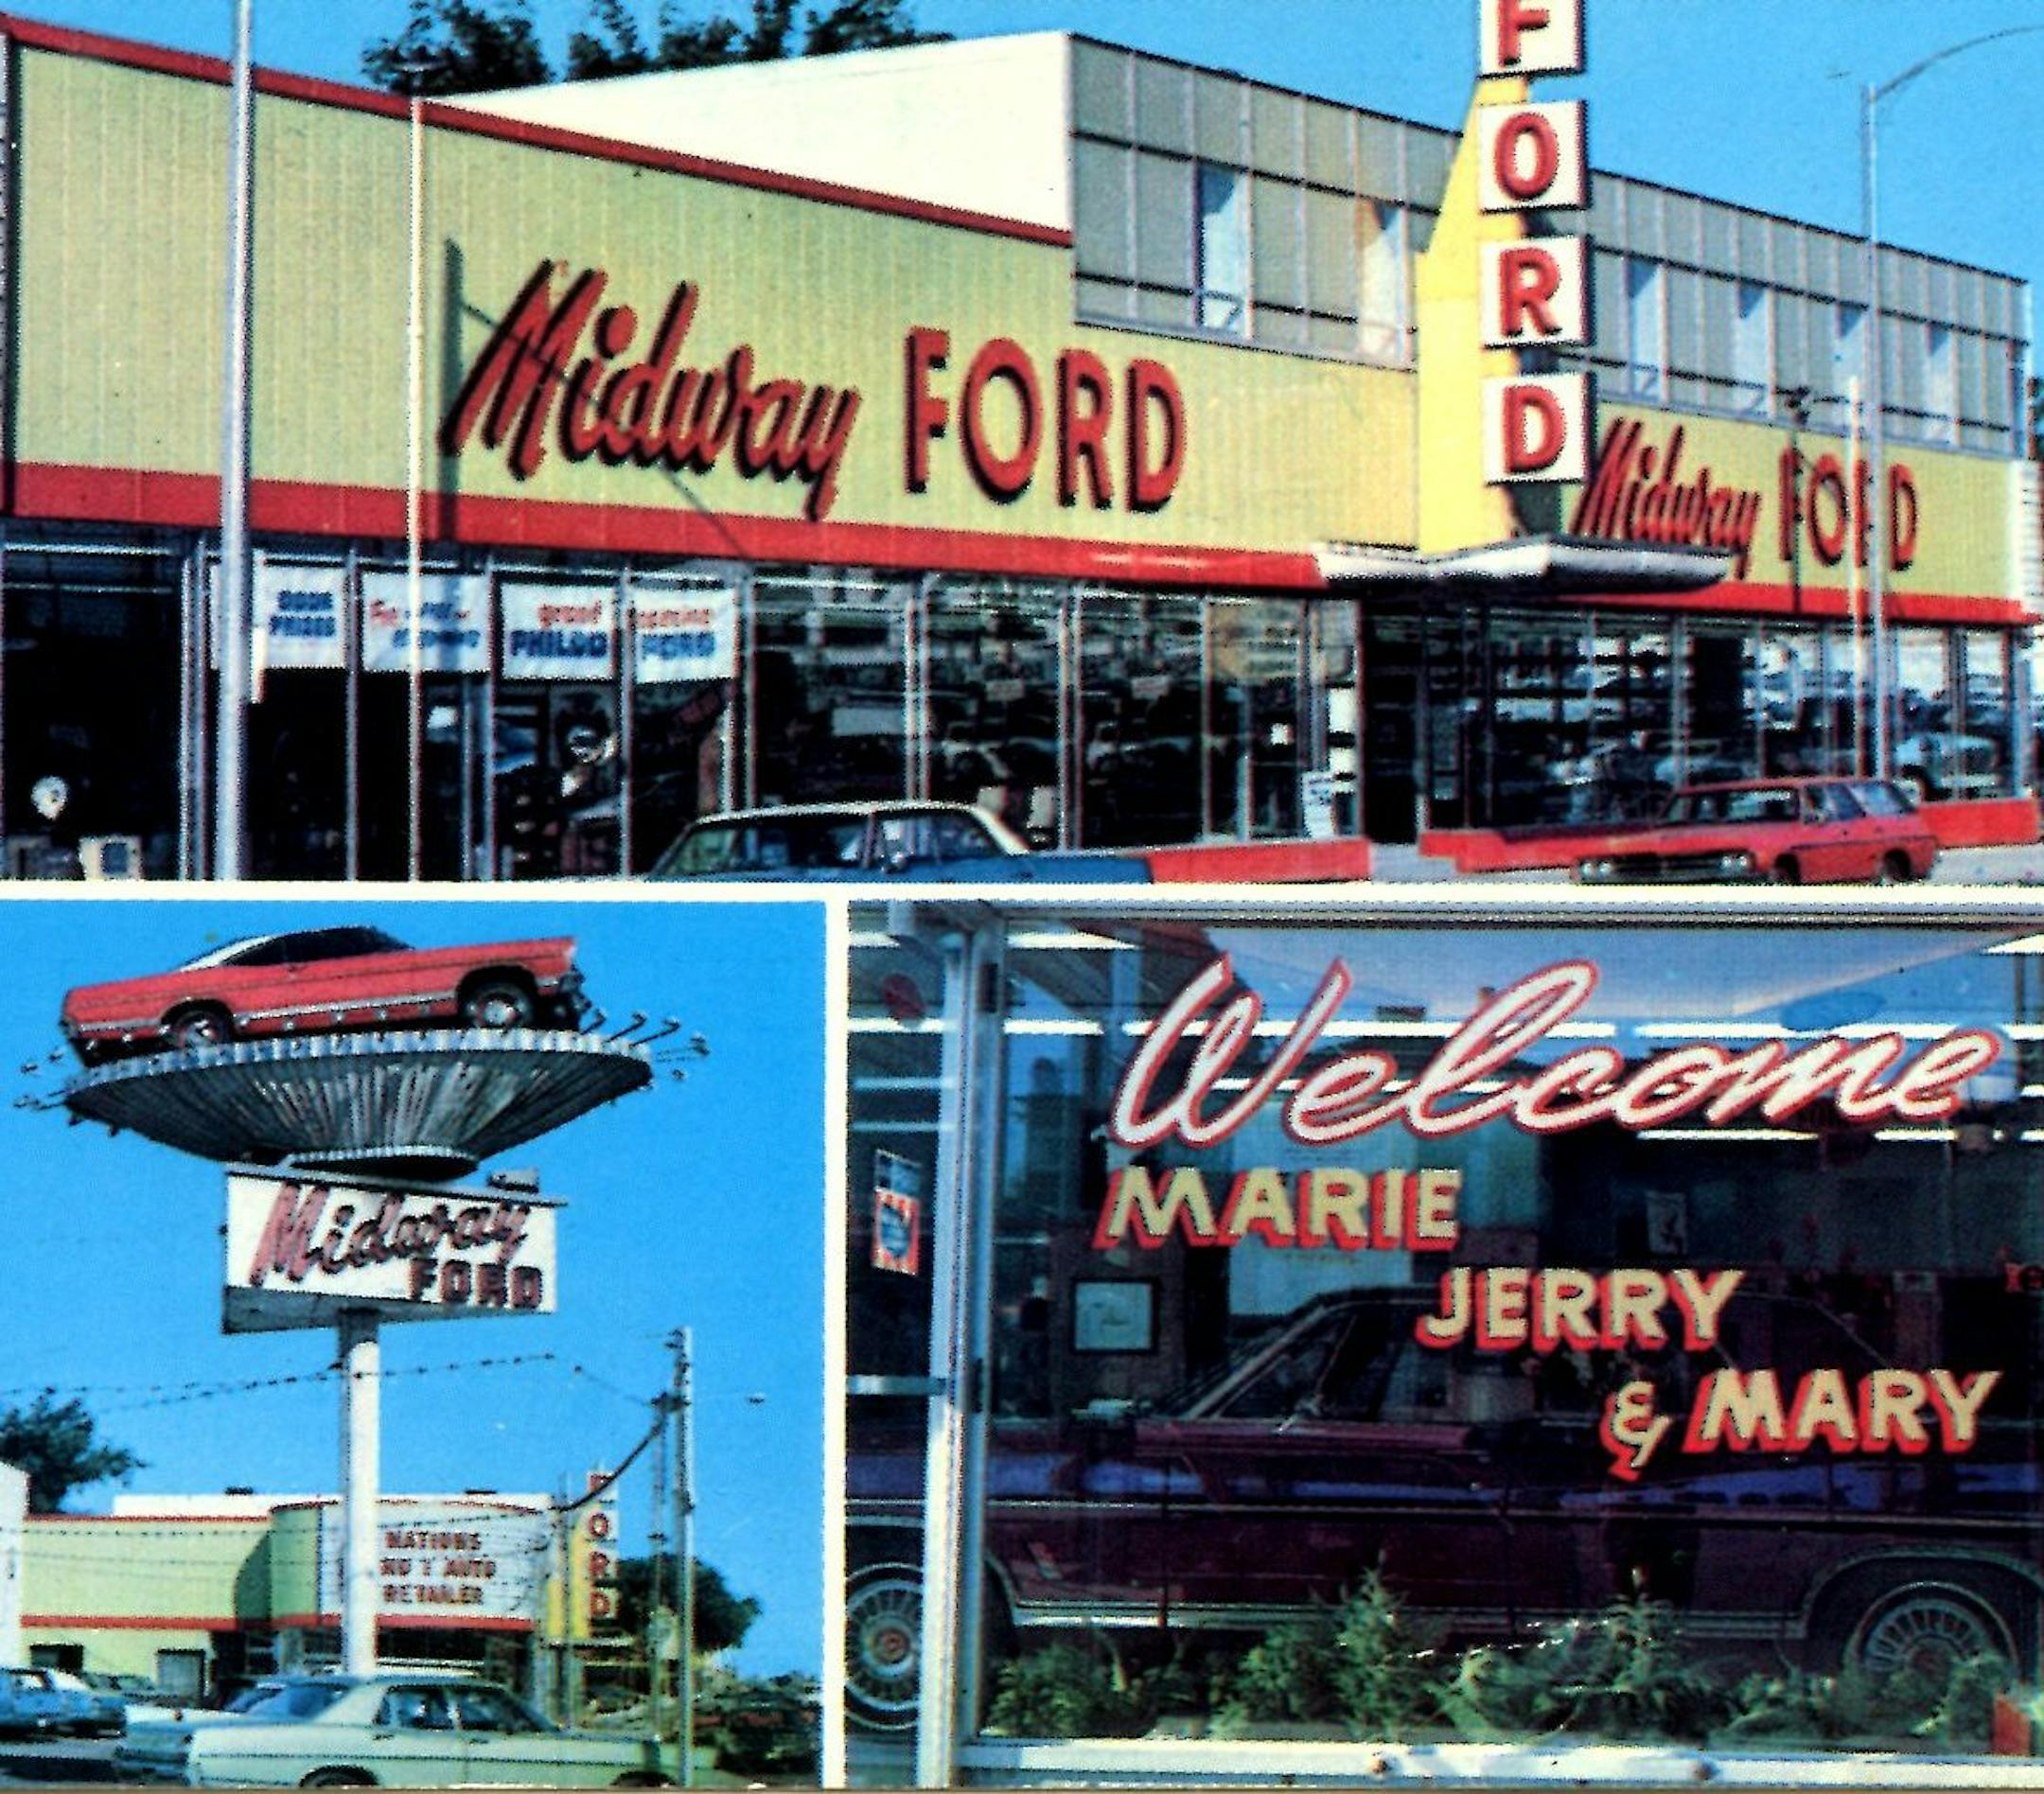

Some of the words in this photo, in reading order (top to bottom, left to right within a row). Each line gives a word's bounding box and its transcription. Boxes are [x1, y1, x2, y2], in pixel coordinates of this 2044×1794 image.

[1492, 0, 1566, 473] FORD
[438, 259, 859, 521] Midway
[904, 326, 1186, 513] FORD
[1568, 416, 1762, 579] Midway
[510, 629, 608, 657] PHILCO
[1107, 953, 2001, 1147] Welcome
[249, 1183, 530, 1287] Midway
[1093, 1167, 1462, 1250] MARIE
[409, 1258, 542, 1310] FORD
[1416, 1268, 1744, 1351] JERRY
[1683, 1369, 2001, 1453] MARY
